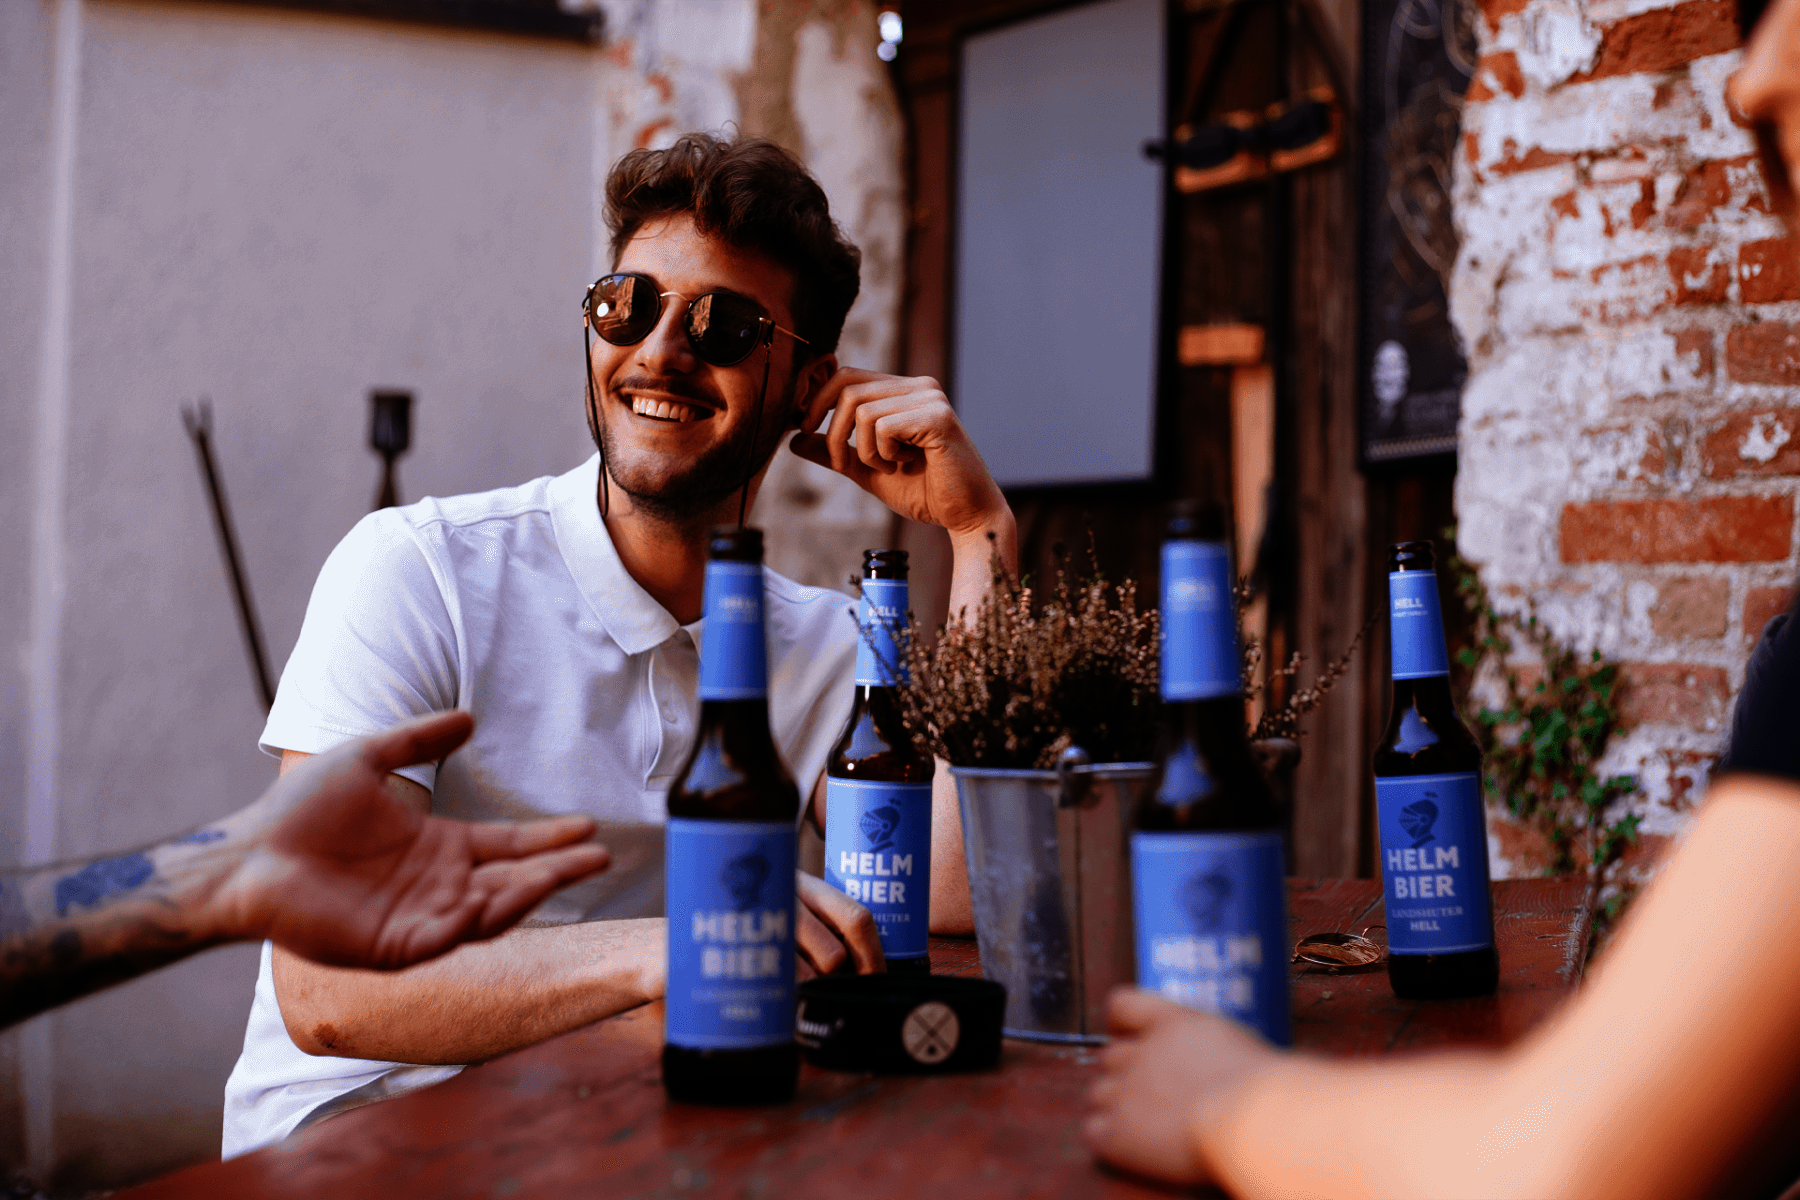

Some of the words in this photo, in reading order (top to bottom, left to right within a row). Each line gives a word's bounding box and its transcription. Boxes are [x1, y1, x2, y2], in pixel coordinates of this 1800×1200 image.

[840, 850, 913, 876] HELM
[1387, 846, 1460, 871] HELM
[845, 878, 906, 904] BIER
[1395, 874, 1456, 899] BIER
[691, 909, 788, 942] HELM
[1410, 921, 1440, 932] HELL
[701, 946, 780, 978] BIER
